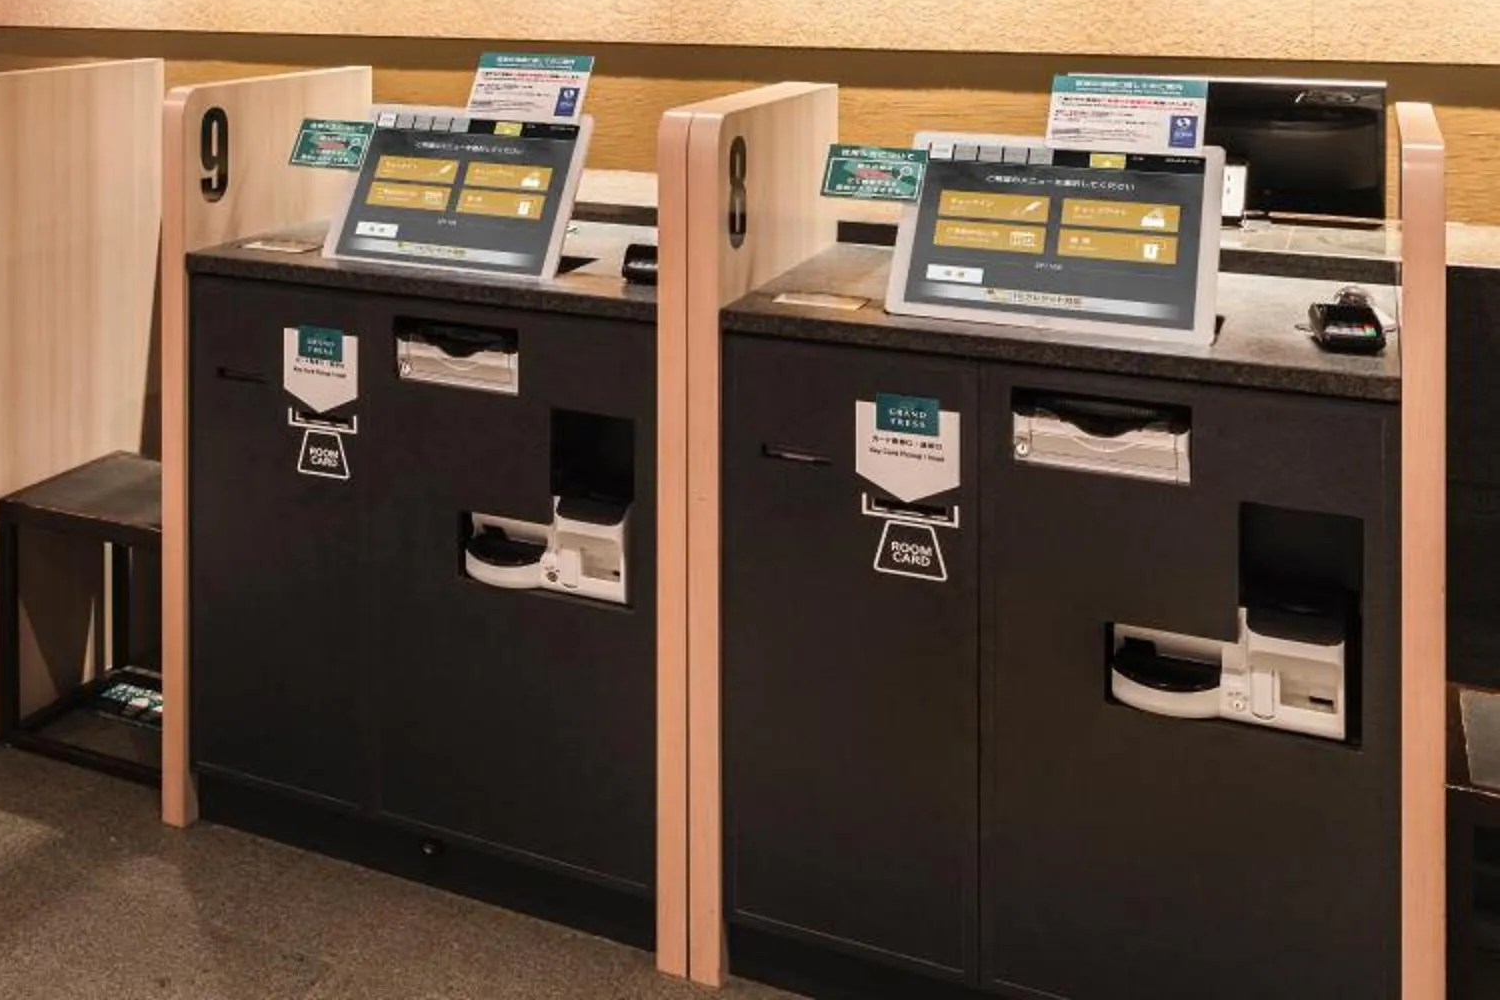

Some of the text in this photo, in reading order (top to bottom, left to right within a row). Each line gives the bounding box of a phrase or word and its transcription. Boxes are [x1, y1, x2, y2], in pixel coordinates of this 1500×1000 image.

[200, 106, 229, 204] 9
[729, 135, 747, 249] 8
[888, 407, 927, 419] GRAND
[891, 540, 933, 557] ROOM
[892, 550, 931, 567] CARD
